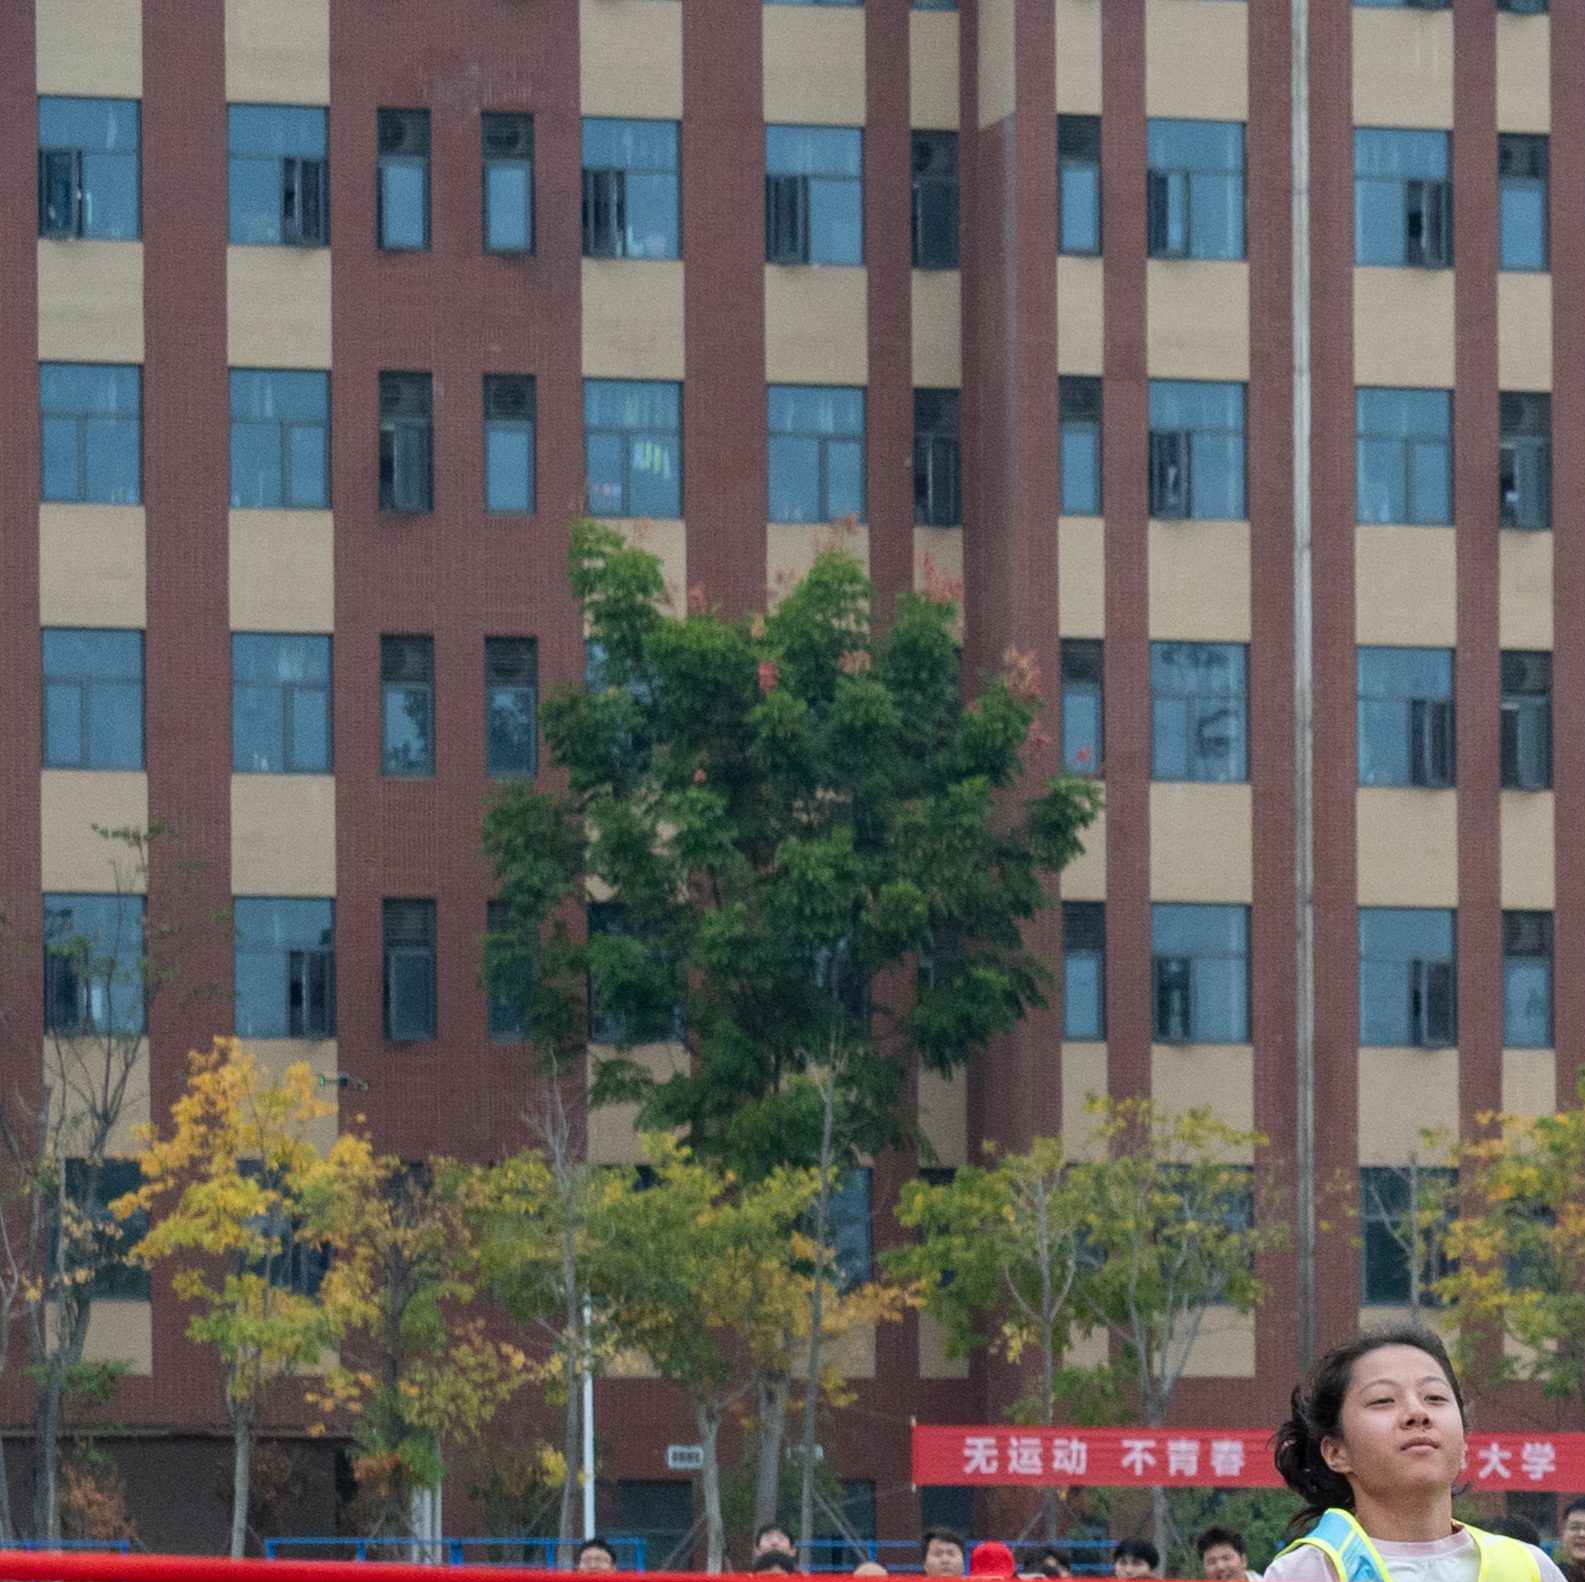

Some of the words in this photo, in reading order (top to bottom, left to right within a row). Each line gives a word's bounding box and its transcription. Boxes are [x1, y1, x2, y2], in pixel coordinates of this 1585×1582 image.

[963, 1436, 1088, 1475] 无运动
[1121, 1438, 1245, 1477] 不青春
[1461, 1441, 1556, 1480] 大学
